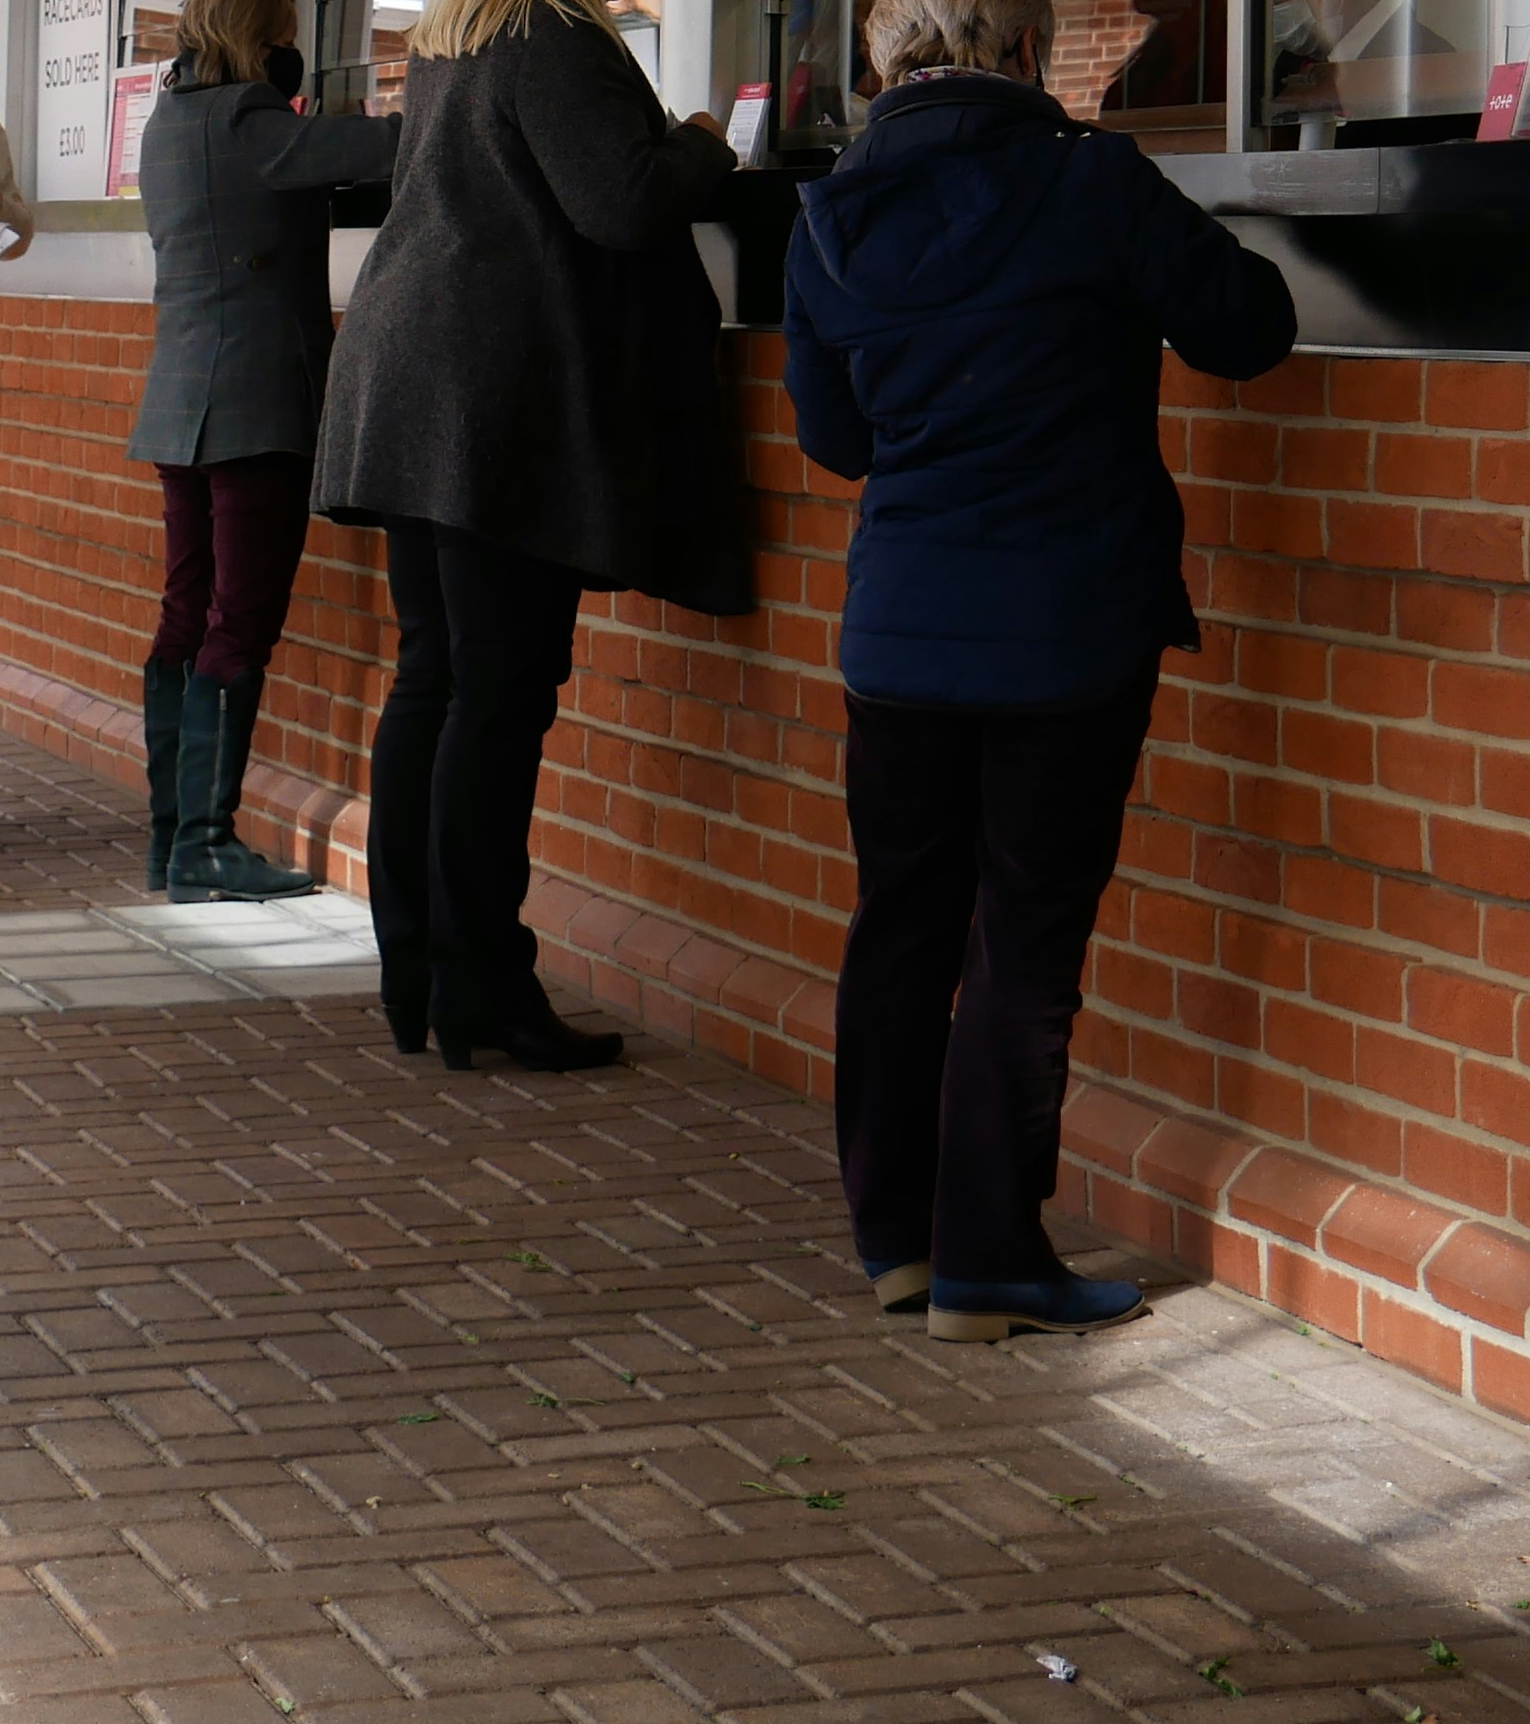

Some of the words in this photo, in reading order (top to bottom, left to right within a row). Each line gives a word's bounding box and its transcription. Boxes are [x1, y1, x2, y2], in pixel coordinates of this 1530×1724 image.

[45, 56, 72, 89] SOLD
[74, 51, 100, 84] HERE
[1488, 93, 1513, 111] tote
